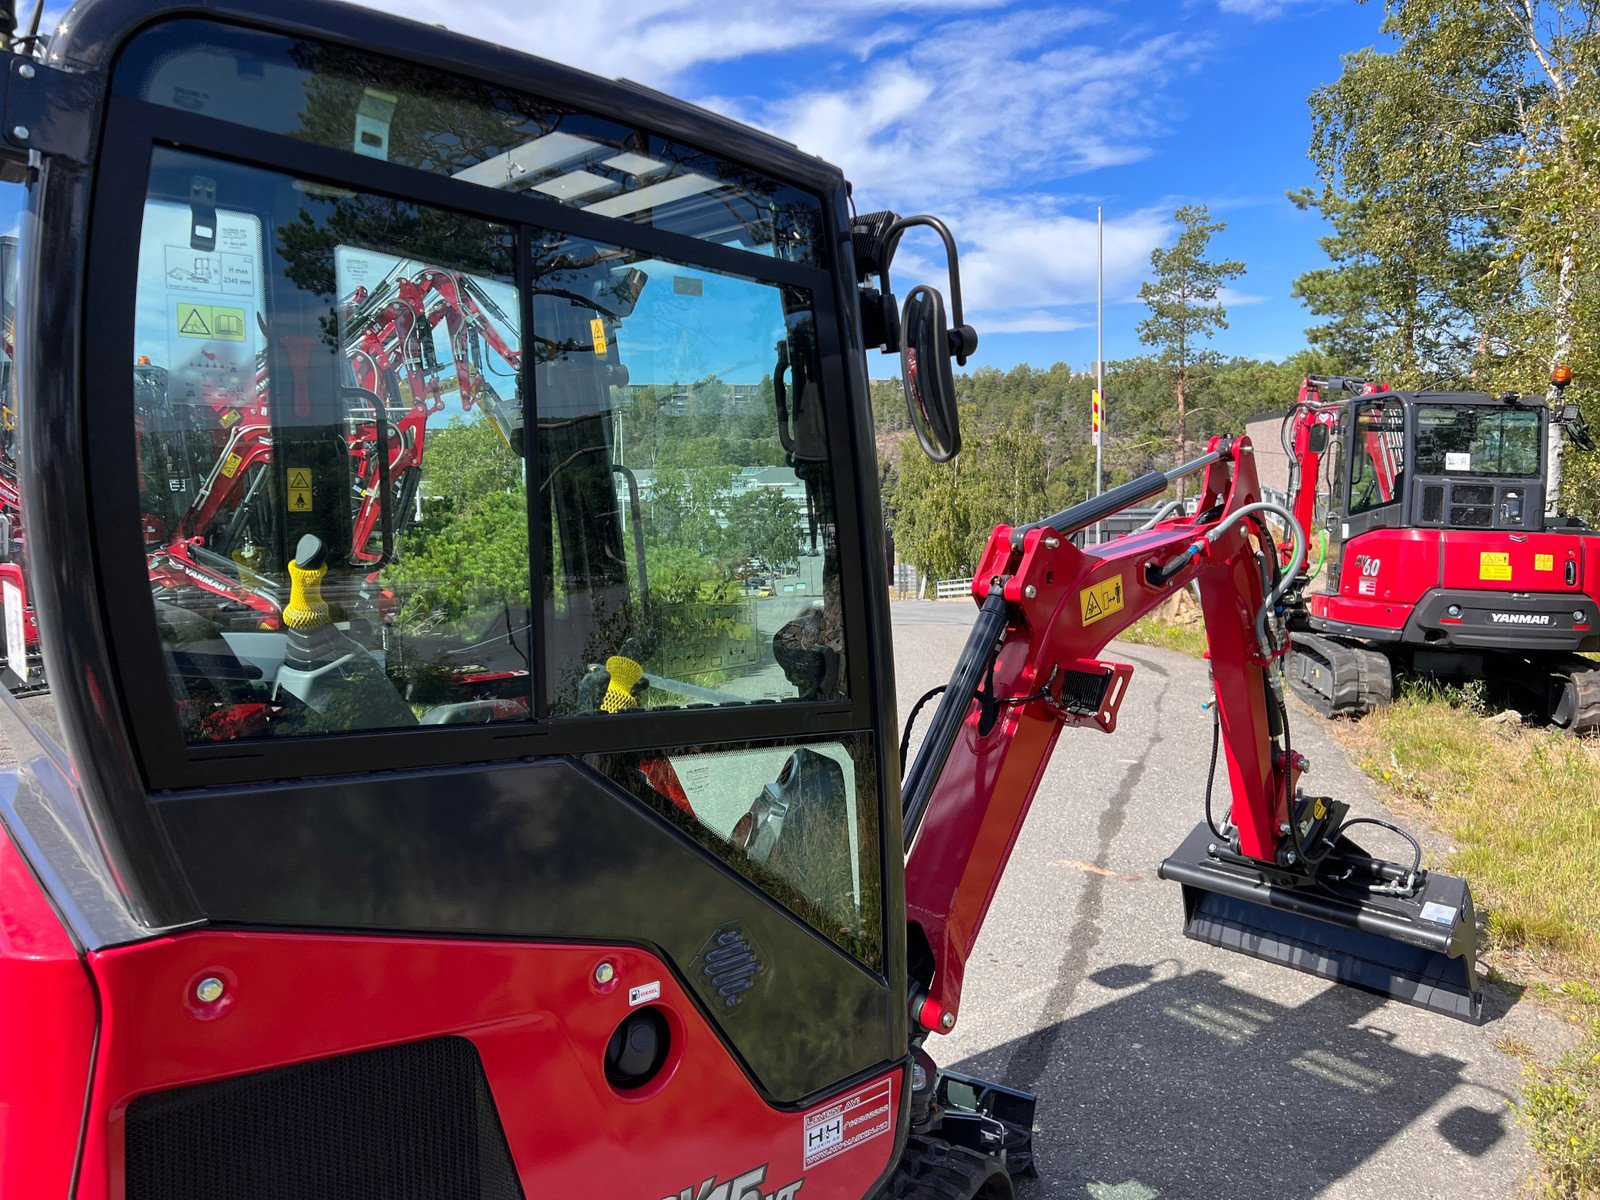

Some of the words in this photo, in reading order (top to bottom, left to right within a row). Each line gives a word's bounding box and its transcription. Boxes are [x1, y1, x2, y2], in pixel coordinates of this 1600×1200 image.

[185, 567, 227, 592] YANMAR
[1491, 613, 1550, 625] YANMAR
[640, 988, 658, 997] DIESEL
[808, 1139, 832, 1153] MASKIN
